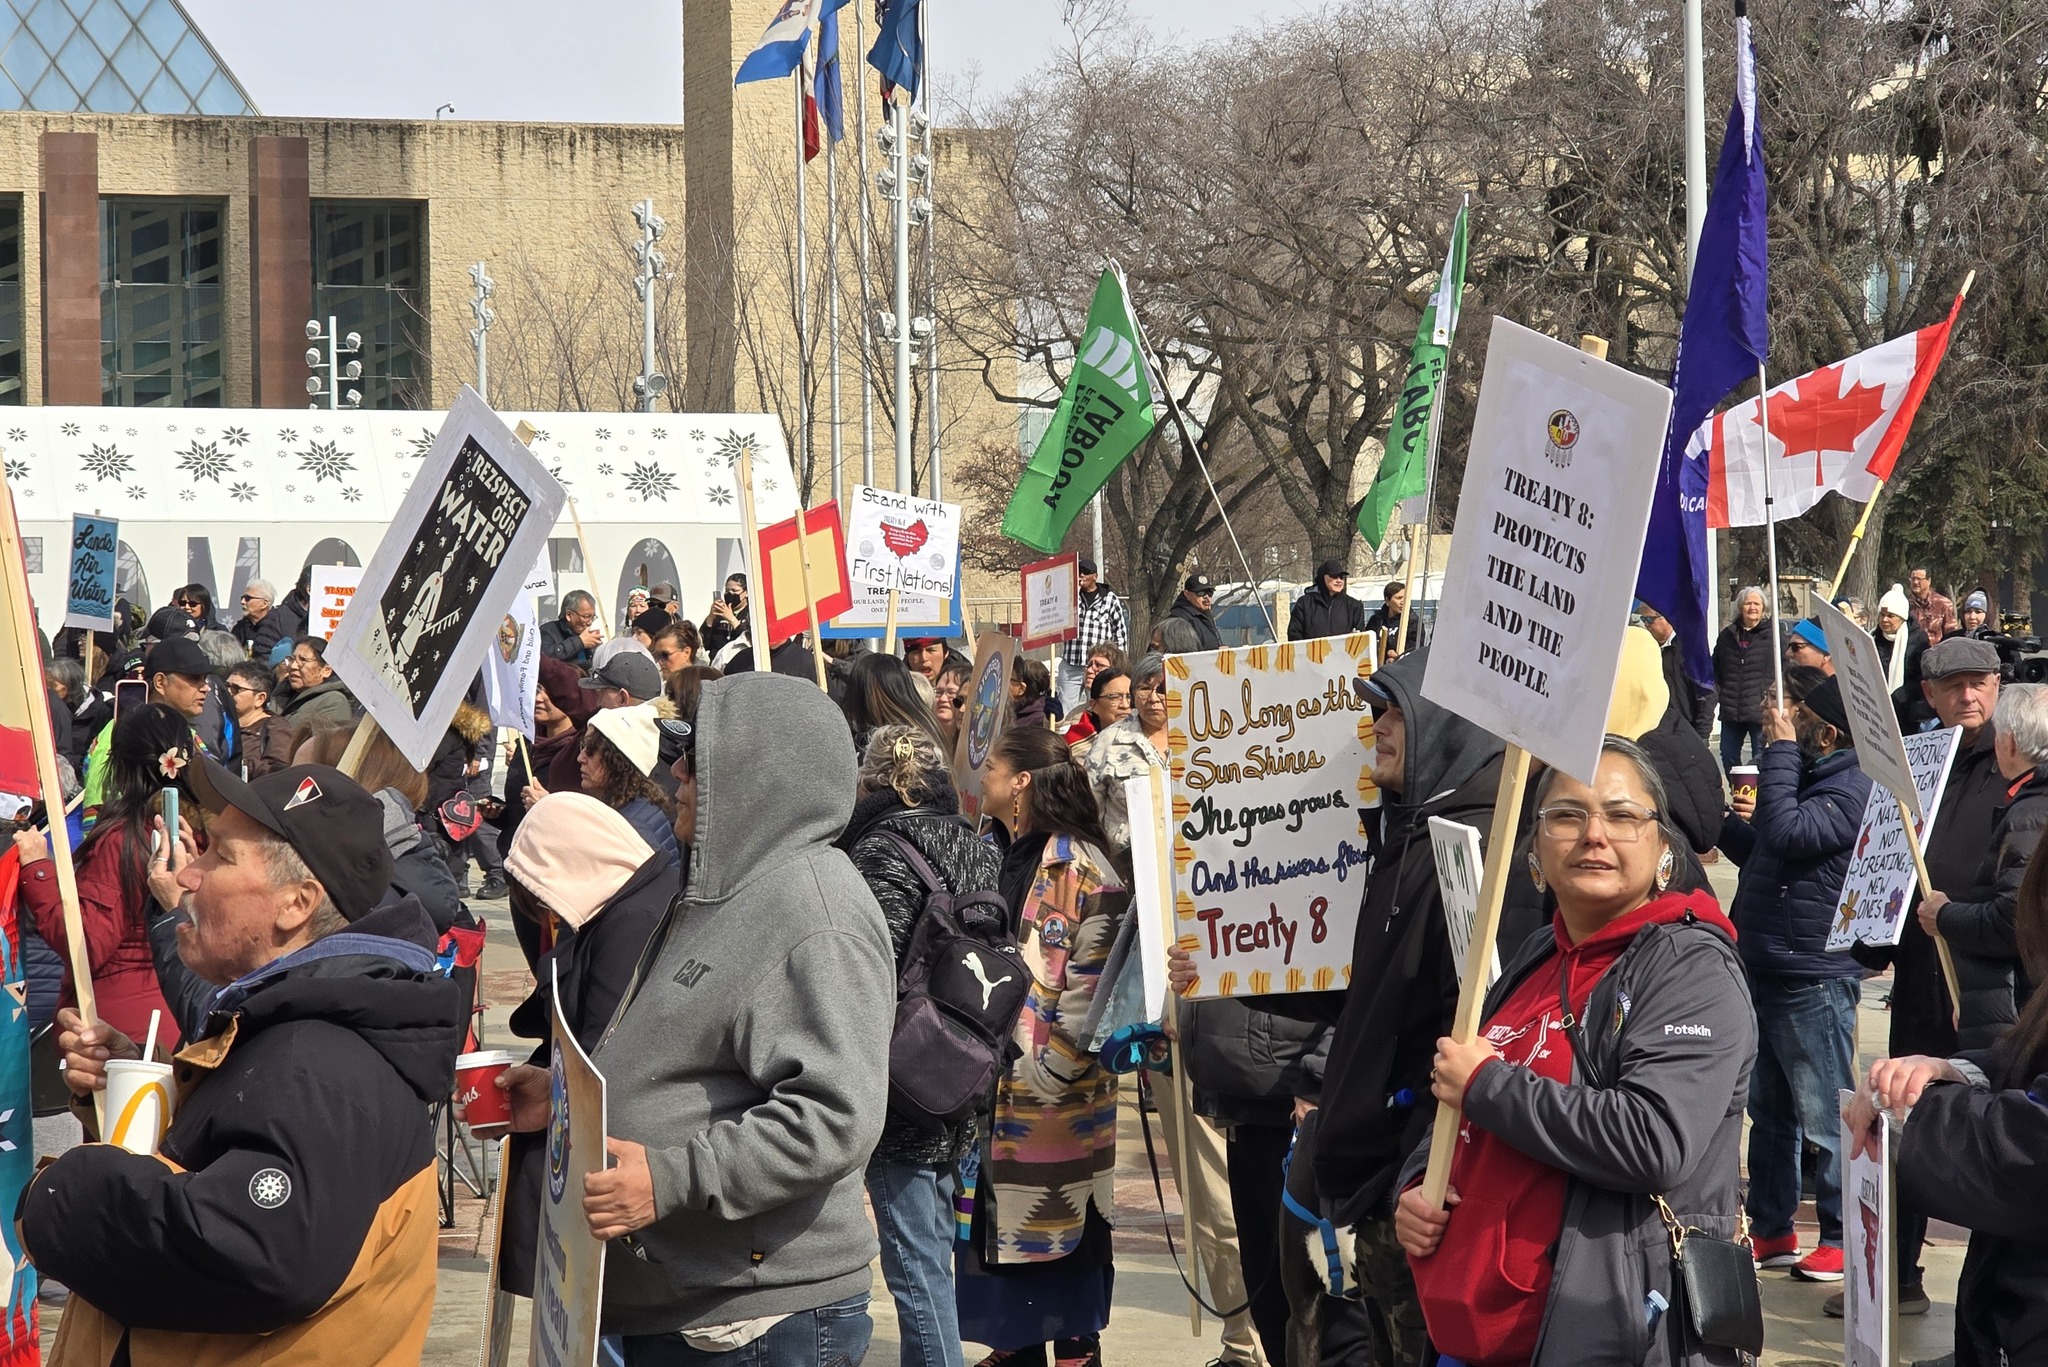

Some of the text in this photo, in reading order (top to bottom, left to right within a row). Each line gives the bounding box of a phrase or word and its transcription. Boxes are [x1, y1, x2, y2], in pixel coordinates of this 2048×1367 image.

[471, 453, 528, 520] REZSPECT
[862, 487, 947, 519] Stand with
[1504, 467, 1595, 530] TREATY 8:
[438, 480, 506, 568] WATER
[491, 505, 516, 538] OUR
[1493, 511, 1587, 575] PROTECTS
[71, 575, 111, 605] Water
[853, 558, 953, 598] First Nations!
[1487, 554, 1576, 616] THE LAND
[1482, 600, 1564, 658] AND THE
[1478, 641, 1550, 699] PEOPLE.
[1189, 680, 1234, 742] As
[1238, 678, 1296, 743] long
[1296, 698, 1322, 720] as
[1185, 744, 1326, 793] Sun Shines
[1182, 789, 1351, 848] The grass grows
[1879, 828, 1903, 850] NOT
[1191, 859, 1239, 897] And
[1240, 856, 1274, 889] the
[1859, 851, 1906, 878] CREATING
[1866, 876, 1889, 897] NEW
[1197, 896, 1329, 965] Treaty 8
[1857, 899, 1883, 920] ONES
[672, 958, 712, 990] CAT
[1664, 1024, 1712, 1037] Potskin
